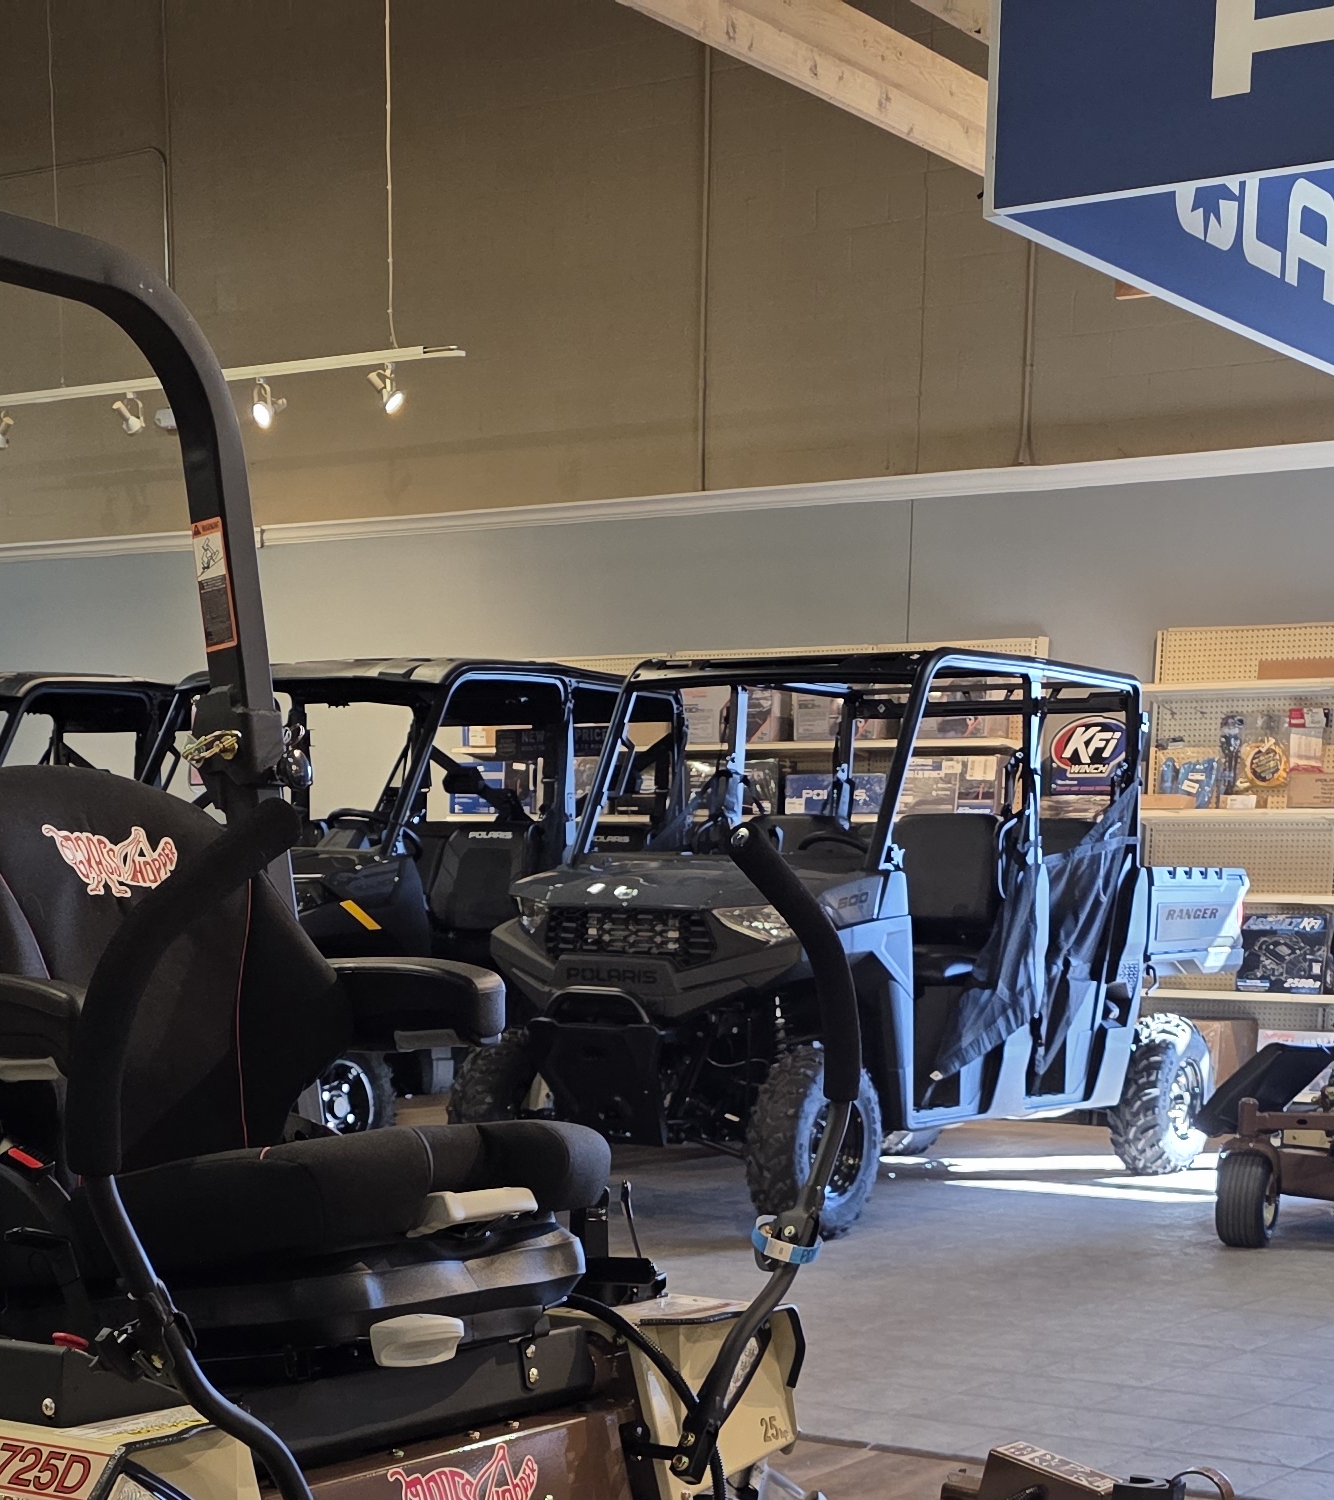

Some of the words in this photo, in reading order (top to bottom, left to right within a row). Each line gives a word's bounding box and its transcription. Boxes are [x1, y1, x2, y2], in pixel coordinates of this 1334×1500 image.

[1061, 726, 1122, 764] KFi
[1069, 764, 1110, 774] WINCH
[468, 831, 514, 840] POLARIS
[1165, 907, 1219, 921] RANGER
[566, 966, 658, 985] POLARIS
